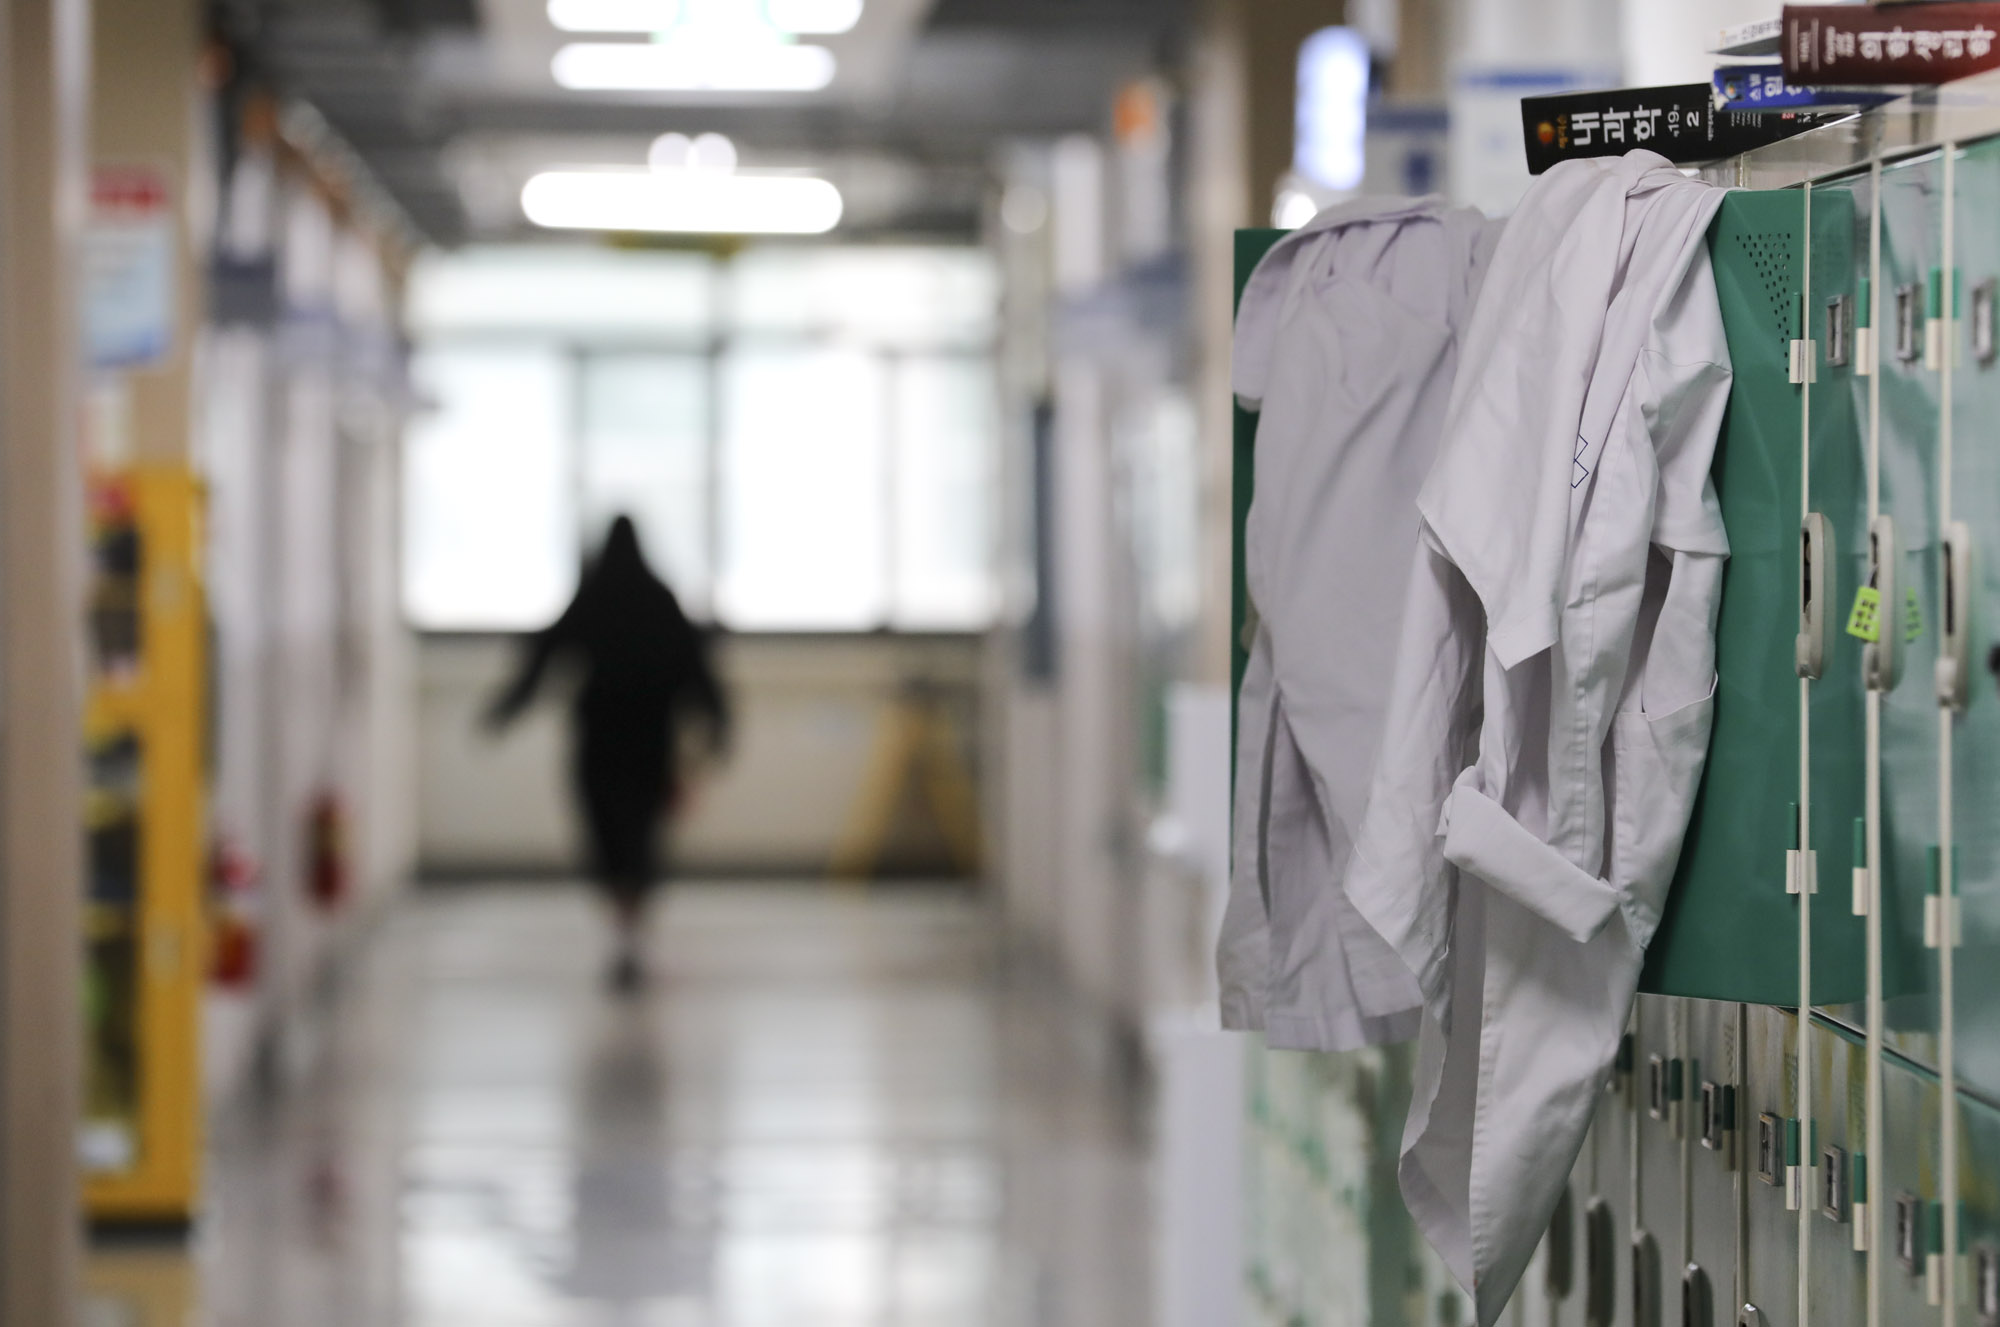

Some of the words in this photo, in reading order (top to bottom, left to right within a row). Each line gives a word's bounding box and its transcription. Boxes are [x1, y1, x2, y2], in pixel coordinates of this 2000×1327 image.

[1858, 24, 1997, 62] 의학생리학
[1571, 104, 1662, 147] 내과학
[1686, 111, 1700, 128] 2
